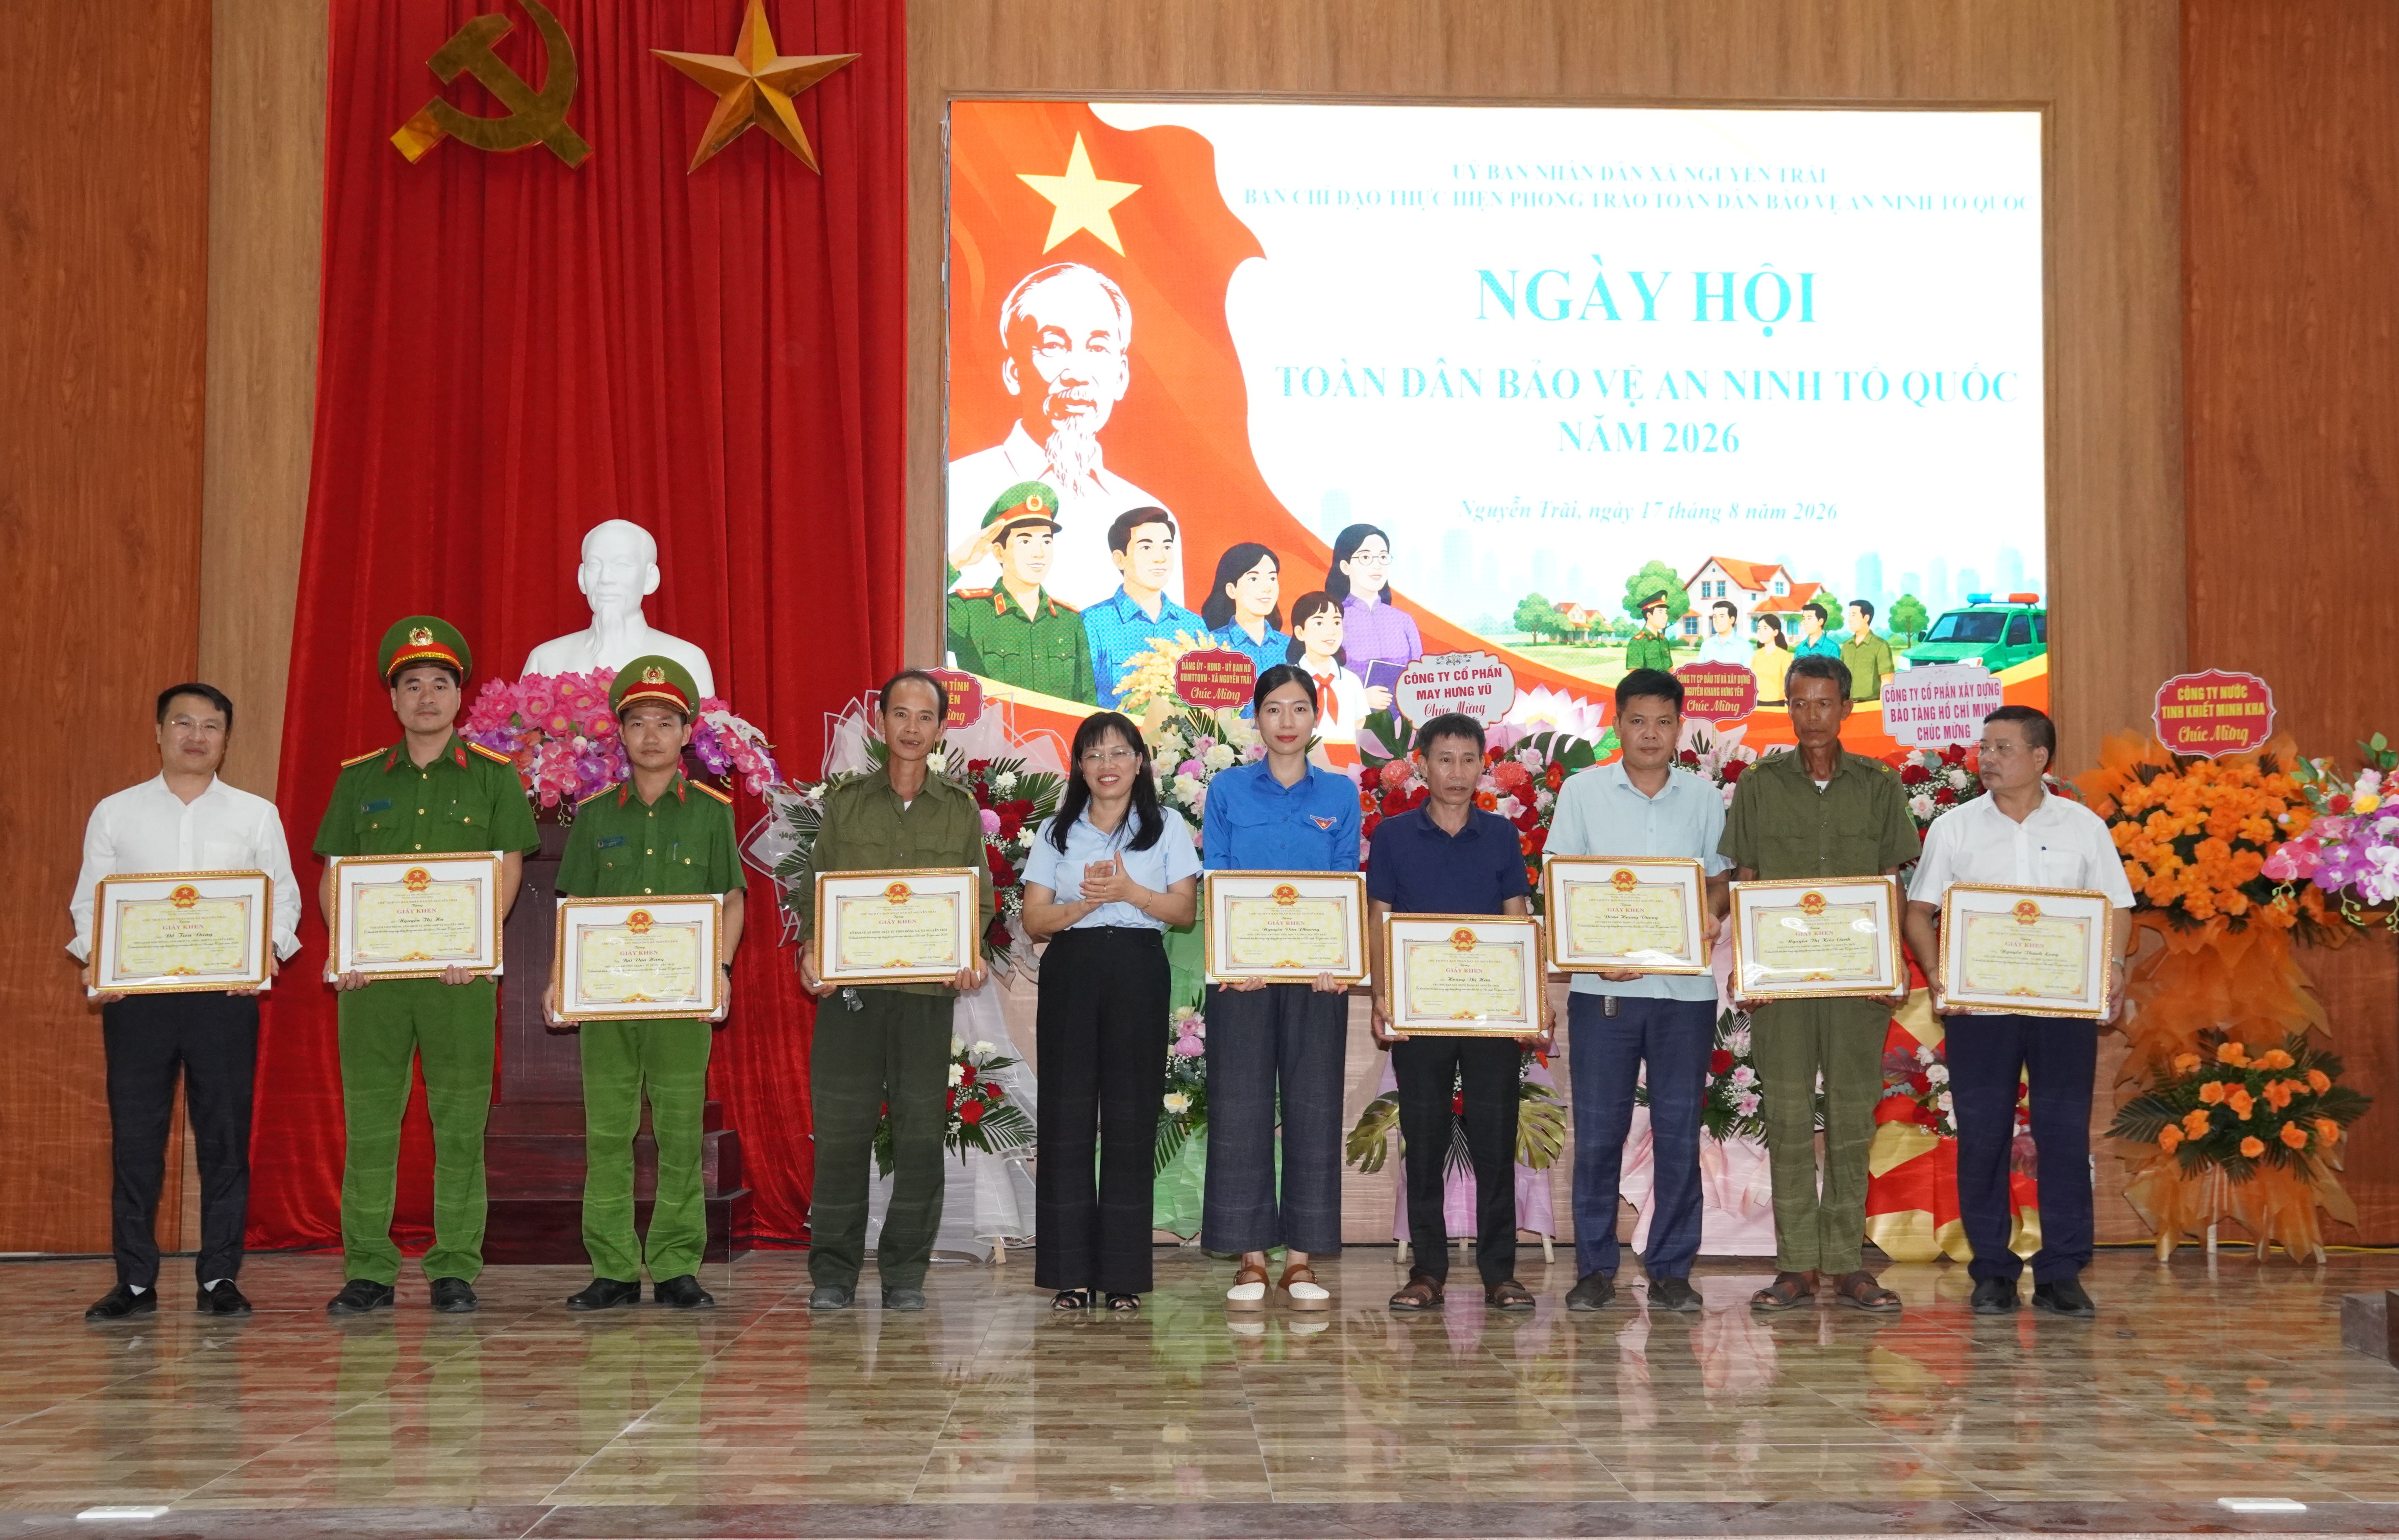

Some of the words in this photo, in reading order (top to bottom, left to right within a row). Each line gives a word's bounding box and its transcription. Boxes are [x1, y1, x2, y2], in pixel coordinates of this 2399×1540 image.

[1488, 165, 1529, 180] BAN
[1536, 160, 1593, 181] NHÂN
[1601, 162, 1643, 182] DÂN
[1650, 163, 1677, 182] XÃ
[1685, 161, 1770, 182] NGUYỄN
[1476, 254, 1672, 322] NGÀY
[1692, 263, 1816, 338] HỘI
[1276, 359, 1385, 397] TOÀN
[1403, 358, 1482, 398] DÂN
[1497, 357, 1581, 399] BẢO
[1593, 363, 1644, 408] VỆ
[1655, 370, 1709, 400] AN
[1724, 371, 1821, 401] NINH
[1835, 367, 1890, 401] TỔ
[1902, 363, 2017, 408] QUỐC
[1559, 415, 1648, 452] NĂM
[1663, 423, 1740, 453] 2026
[1458, 496, 1532, 524] Nguyễn
[1542, 501, 1581, 519] Trãi,
[1590, 502, 1634, 524] ngày
[1643, 502, 1663, 519] 17
[1669, 502, 1722, 523] tháng
[1729, 503, 1739, 519] 8
[1746, 504, 1786, 519] năm
[1794, 503, 1837, 520] 2026
[1182, 659, 1195, 670] ĐẢNG
[1232, 664, 1243, 672] BAN
[1244, 664, 1251, 672] ND
[1404, 672, 1434, 684] CÔNG
[1438, 672, 1450, 682] TY
[1454, 667, 1468, 681] CỔ
[1472, 665, 1502, 679] PHẦN
[949, 678, 969, 691] TỈNH
[1180, 673, 1207, 682] UBMTTQVN
[1212, 673, 1218, 683] XÃ
[1219, 672, 1239, 684] NGUYỄN
[1677, 673, 1690, 683] CÔNG
[1690, 674, 1696, 683] TY
[1697, 674, 1703, 683] CP
[1727, 673, 1736, 684] XÂY
[1191, 687, 1212, 699] Chúc
[1213, 688, 1240, 704] Mừng
[1416, 689, 1440, 700] MAY
[1444, 686, 1474, 698] HƯNG
[1478, 683, 1492, 695] VŨ
[1685, 684, 1703, 696] NGUYỄN
[1704, 687, 1720, 696] KHANG
[1721, 686, 1733, 696] HƯNG
[1885, 687, 1907, 703] CÔNG
[1909, 688, 1918, 701] TY
[1921, 681, 1931, 700] CỔ
[1959, 682, 1974, 698] XÂY
[1977, 682, 2000, 699] DỰNG
[2177, 685, 2204, 701] CÔNG
[2206, 686, 2219, 699] TY
[2220, 683, 2248, 699] NƯỚC
[947, 709, 965, 725] ừng
[1687, 700, 1709, 711] Chúc
[1710, 700, 1740, 716] Mừng
[1890, 702, 1909, 722] BẢO
[1911, 704, 1936, 721] TÀNG
[1954, 701, 1969, 718] CHÍ
[2162, 706, 2184, 719] TINH
[2186, 700, 2214, 718] KHIẾT
[2216, 703, 2243, 716] MINH
[2244, 702, 2265, 715] KHA
[1917, 723, 1940, 740] CHÚC
[1944, 721, 1970, 740] MỪNG
[2178, 726, 2208, 743] Chúc
[2210, 724, 2249, 746] Mừng
